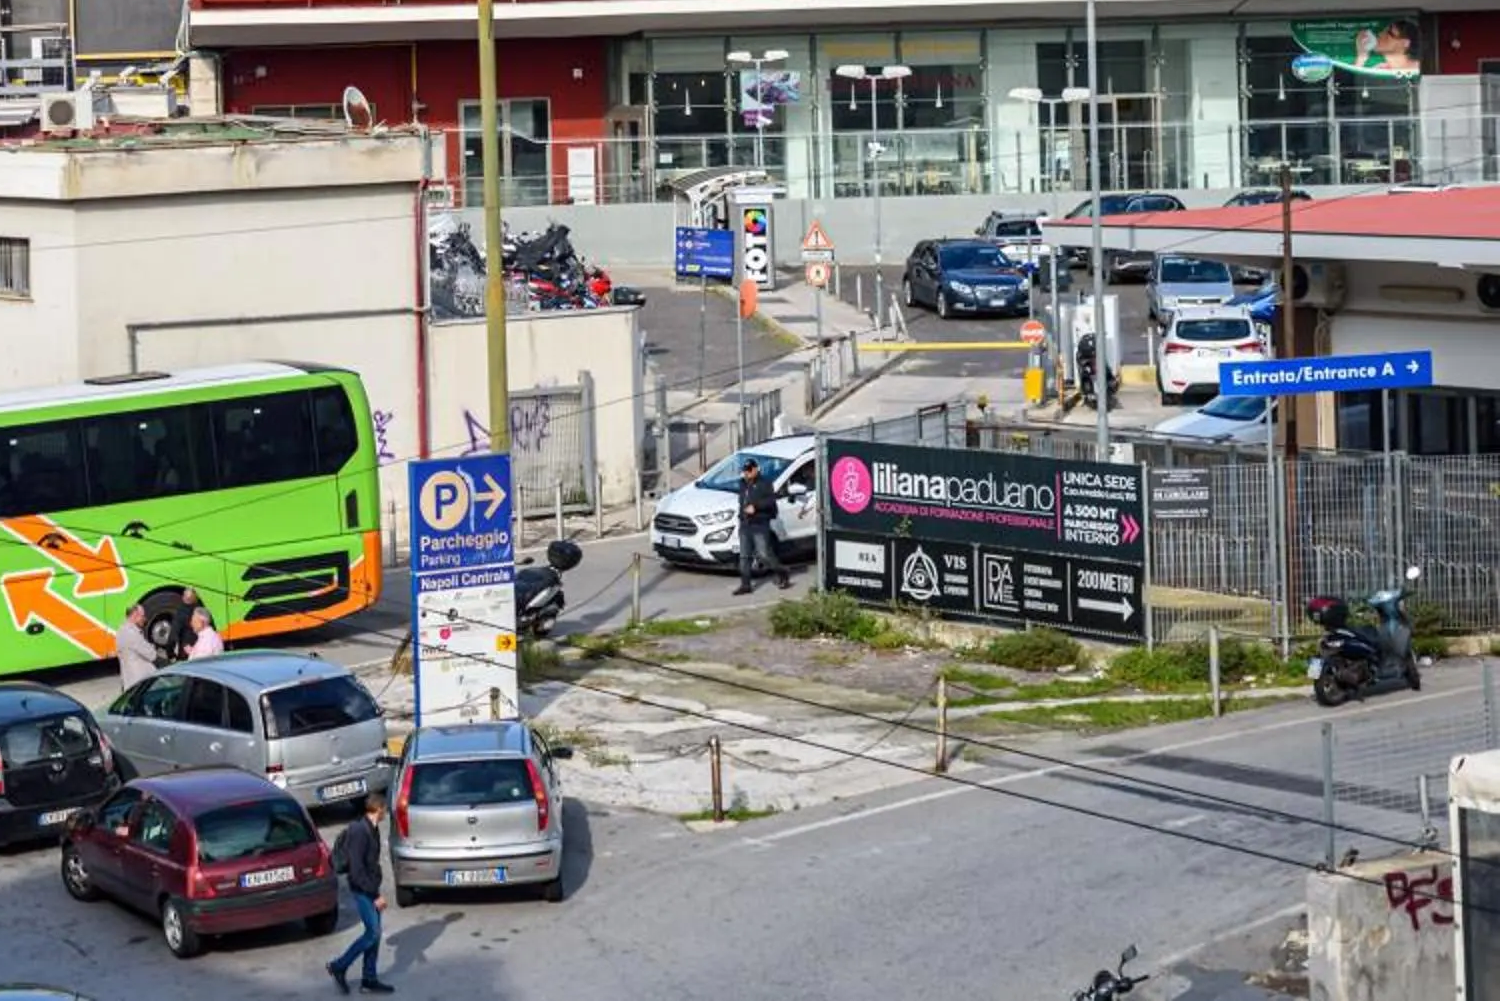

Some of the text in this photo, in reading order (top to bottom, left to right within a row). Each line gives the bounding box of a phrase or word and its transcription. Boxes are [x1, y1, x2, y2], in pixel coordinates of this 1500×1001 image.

[1232, 361, 1395, 386] Entrata/Entrance A
[1063, 471, 1102, 487] UNICA
[1103, 474, 1136, 490] SEDE
[434, 483, 459, 521] P
[1064, 503, 1073, 517] A
[1099, 506, 1118, 520] MT
[874, 502, 1055, 529] ACCADEMIA DI FORMAZIONE PROFESSIONALE
[421, 529, 509, 552] Parcheggio
[1065, 528, 1119, 546] INTERNO
[421, 554, 461, 568] Parking
[943, 553, 967, 570] VIS
[421, 569, 510, 590] Napoli Centrale
[1077, 569, 1099, 589] 200
[1099, 573, 1135, 594] METRI
